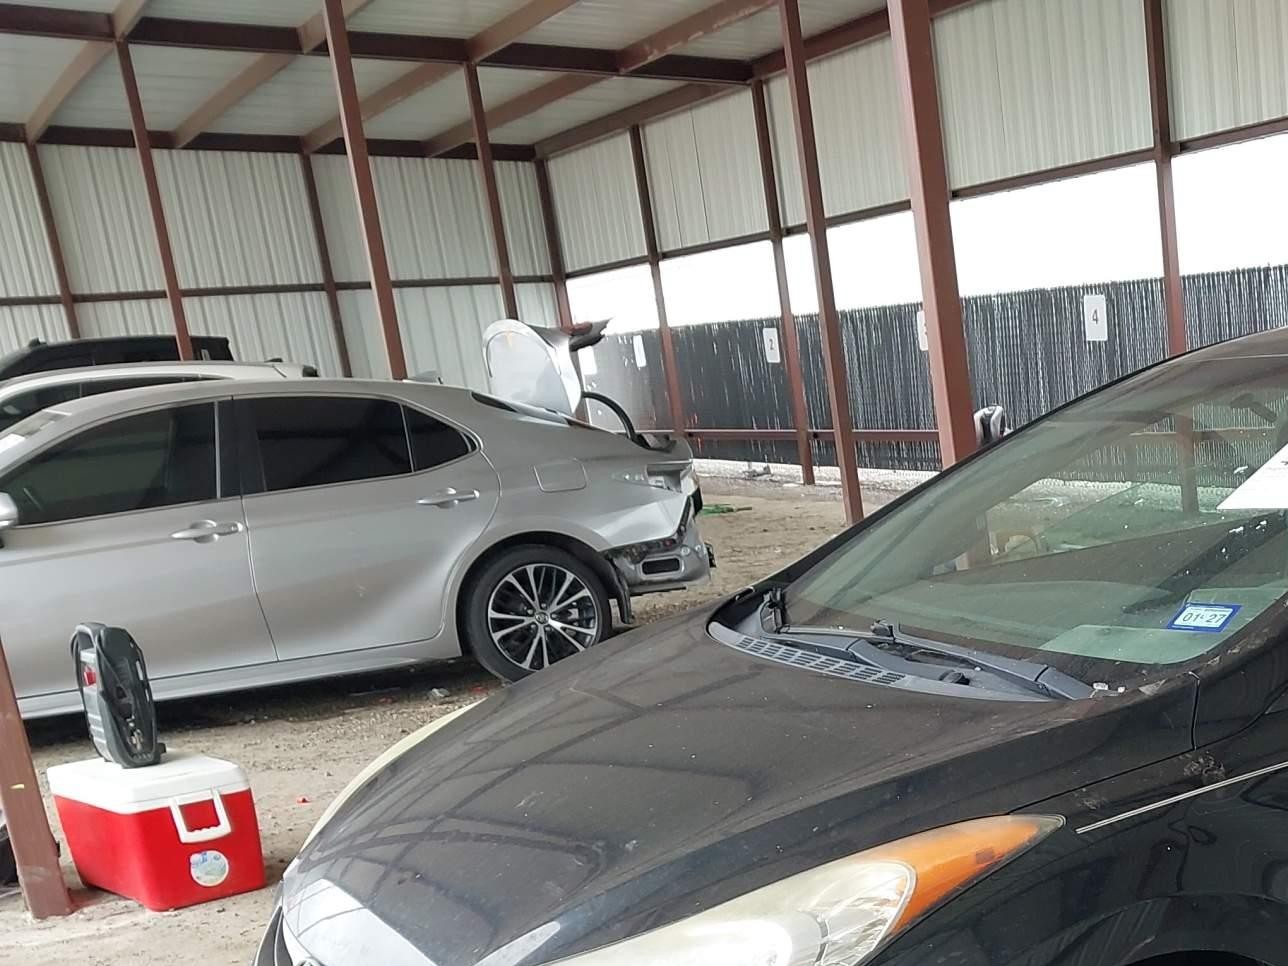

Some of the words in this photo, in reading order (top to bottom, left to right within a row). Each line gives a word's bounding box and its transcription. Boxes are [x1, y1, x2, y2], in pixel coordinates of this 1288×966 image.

[1091, 308, 1099, 325] 4
[768, 338, 775, 351] 2
[1182, 612, 1199, 622] 01
[1205, 613, 1227, 624] 27
